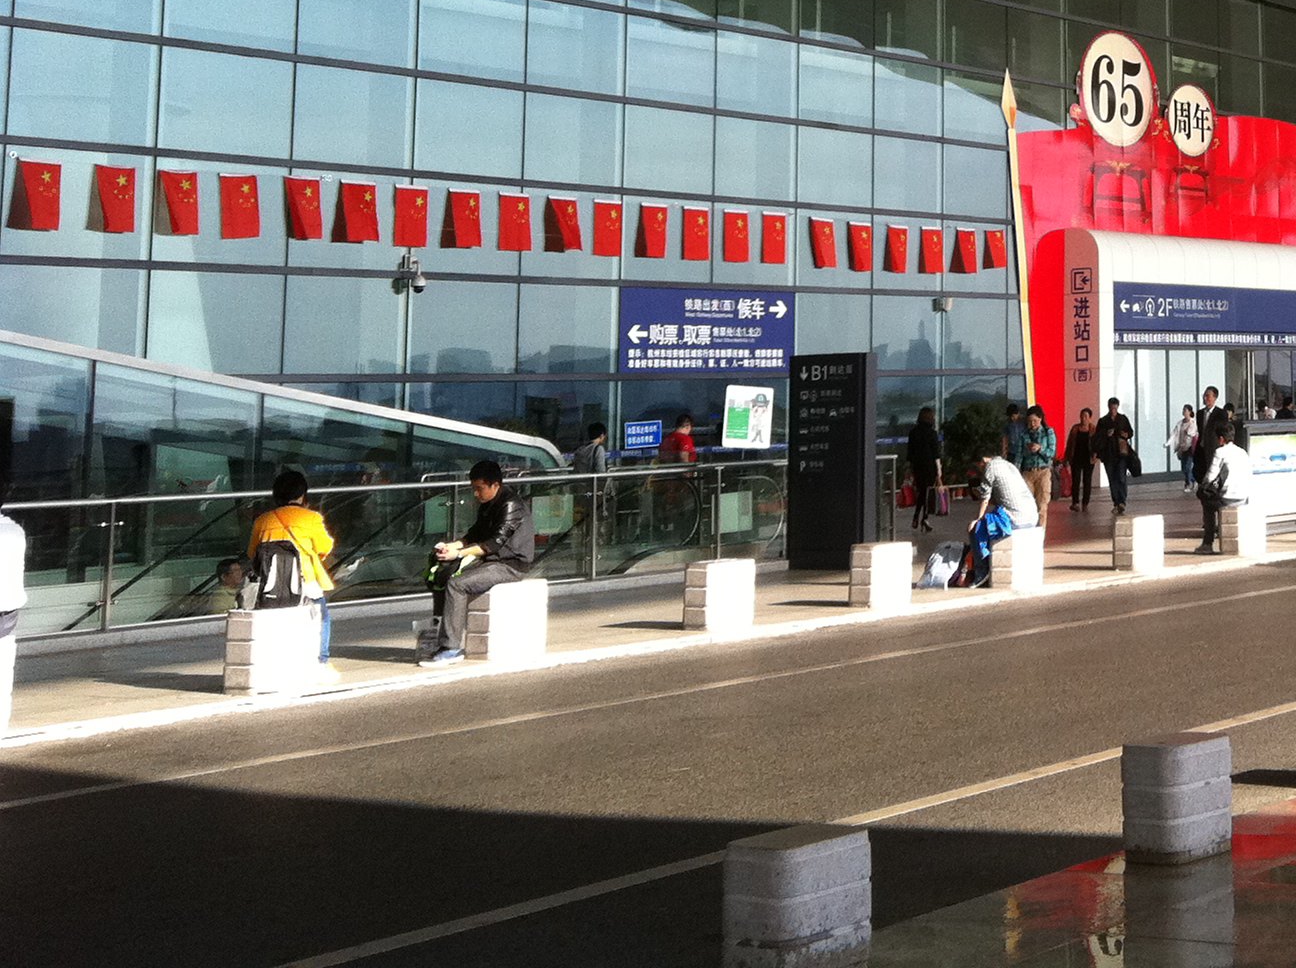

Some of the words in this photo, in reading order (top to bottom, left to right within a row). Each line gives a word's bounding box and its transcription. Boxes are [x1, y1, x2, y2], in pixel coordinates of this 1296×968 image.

[1091, 54, 1144, 127] 65
[1173, 98, 1212, 143] 周年
[737, 297, 766, 320] 候车
[1157, 297, 1173, 317] 2F
[1073, 296, 1091, 362] 进站口
[811, 365, 828, 381] B1
